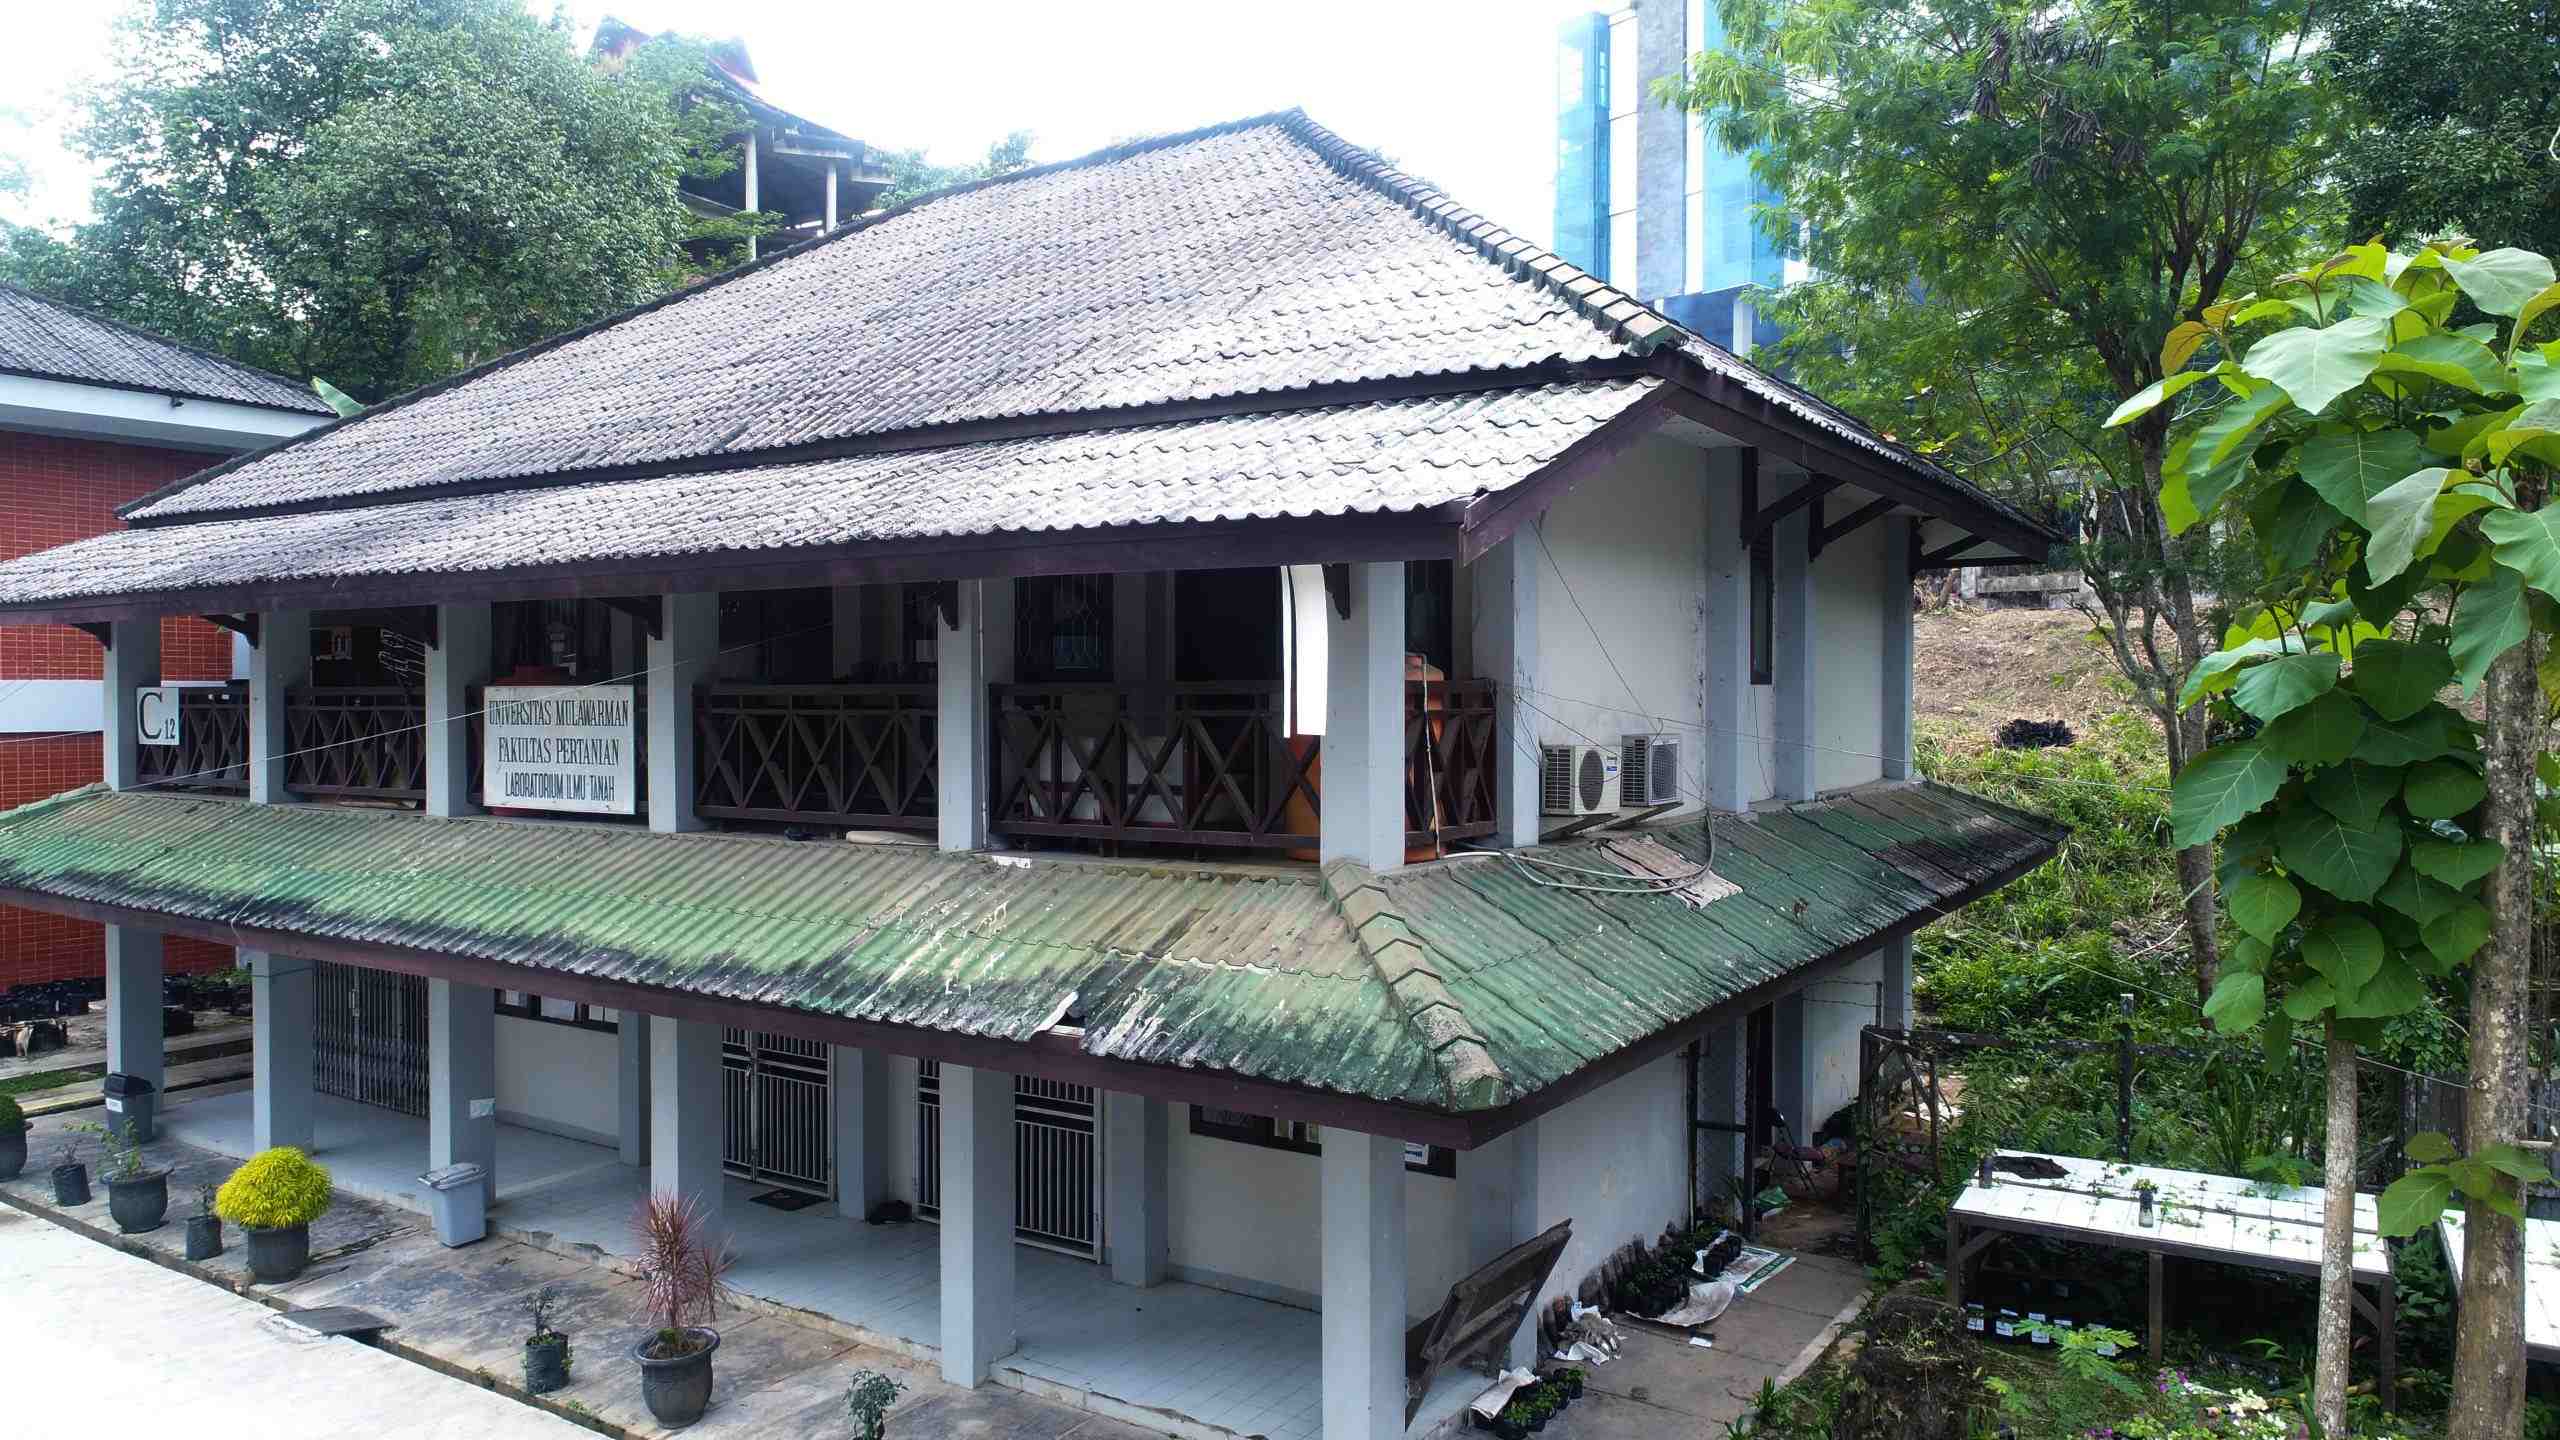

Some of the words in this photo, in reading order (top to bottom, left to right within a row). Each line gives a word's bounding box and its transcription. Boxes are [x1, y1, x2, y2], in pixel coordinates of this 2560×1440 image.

[139, 692, 162, 739] C
[165, 718, 175, 739] 12
[489, 700, 552, 726] UNIVERSITAS
[555, 699, 629, 727] MULAWARMAN
[498, 737, 552, 763] FAKULTAS
[556, 738, 619, 766] PERTANIAN
[505, 772, 563, 799] LABORATORIUM
[566, 773, 585, 800] ILMU
[590, 774, 615, 801] TANAH
